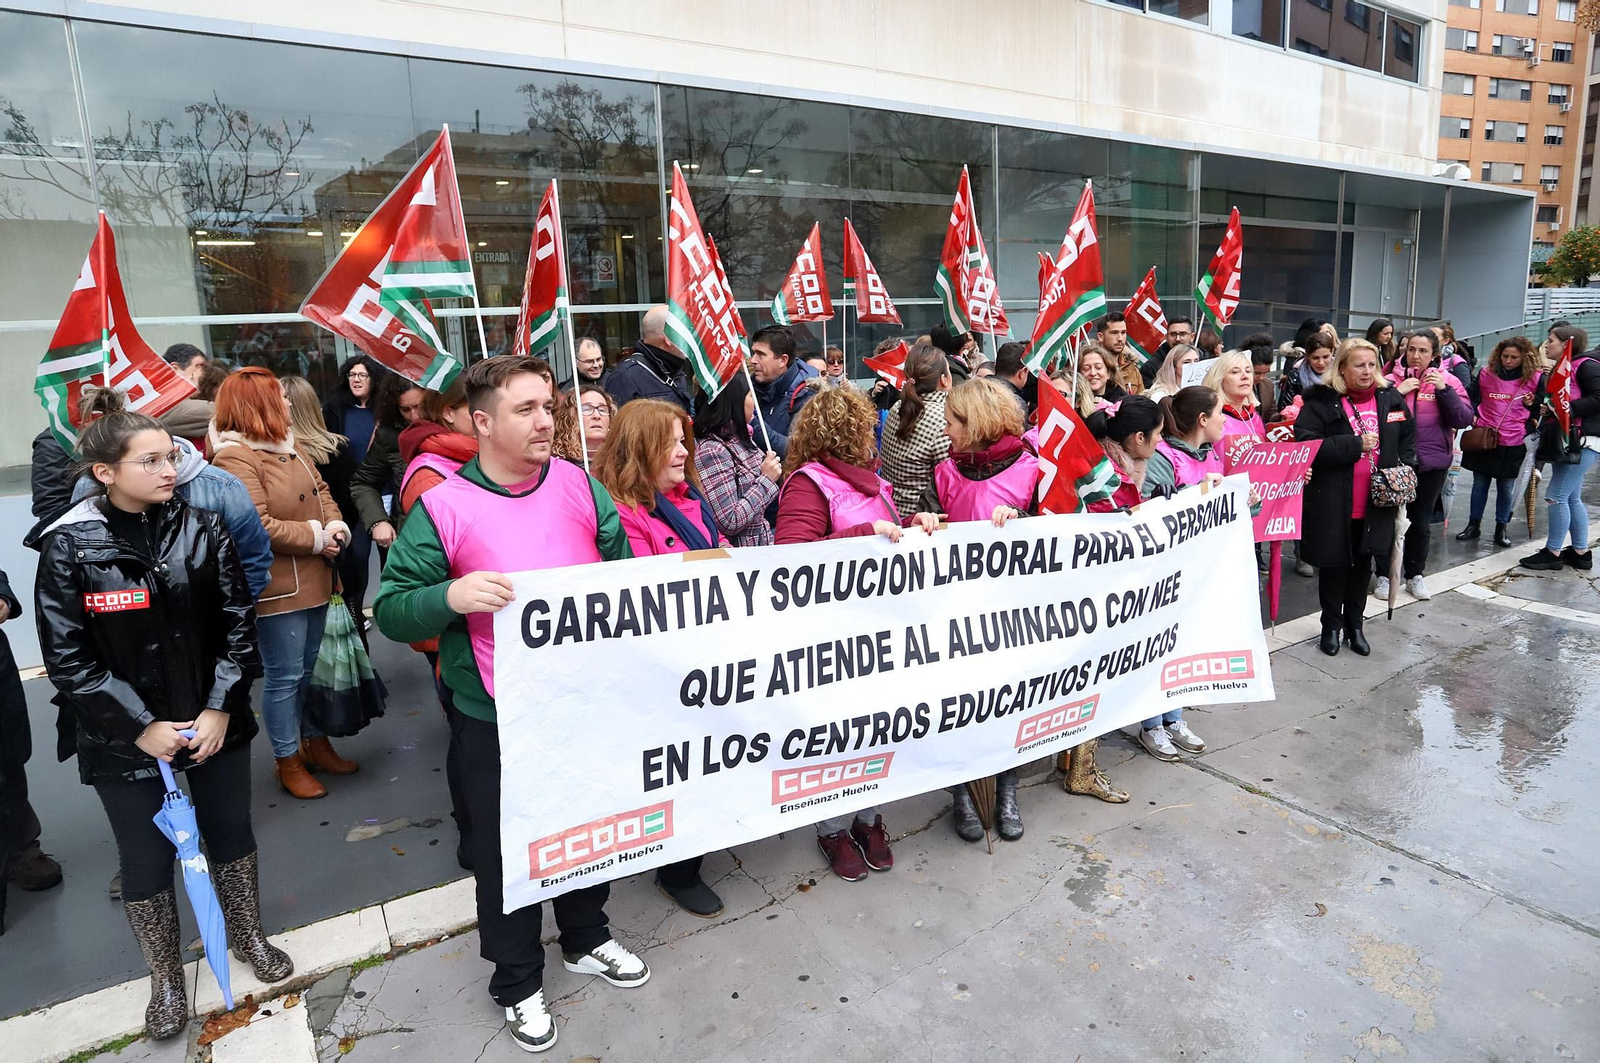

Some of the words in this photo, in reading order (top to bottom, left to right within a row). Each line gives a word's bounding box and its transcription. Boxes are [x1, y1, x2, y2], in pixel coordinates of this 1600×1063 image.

[475, 252, 510, 263] ENTRADA
[789, 273, 806, 316] Huelva
[688, 280, 731, 361] Huelva
[1252, 475, 1305, 501] ROGACIÓN
[1264, 516, 1296, 536] HUELVA
[521, 575, 729, 648] GARANTIA
[736, 570, 760, 616] Y
[770, 550, 925, 612] SOLUCION
[933, 537, 1062, 587] LABORAL
[1072, 530, 1135, 569] PARA
[1139, 524, 1165, 556] EL
[1165, 492, 1238, 549] PERSONAL
[85, 593, 132, 607] CCOO
[680, 659, 757, 709] QUE
[766, 630, 894, 698] ATIENDE
[904, 622, 940, 668] AL
[948, 597, 1098, 660] ALUMNADO
[1106, 589, 1149, 629] CON
[1148, 570, 1182, 612] NEE
[1164, 657, 1229, 682] CCOO
[643, 741, 690, 792] EN
[703, 732, 771, 776] LOS
[781, 700, 931, 761] CENTROS
[938, 660, 1092, 733] EDUCATIVOS
[1093, 622, 1179, 684] PUBLICOS
[1166, 684, 1210, 699] Enseñanza
[1212, 681, 1248, 690] Huelva
[1017, 731, 1060, 754] Enseñanza
[1061, 723, 1088, 740] Huelva
[1021, 704, 1080, 739] CCOO
[778, 762, 865, 796] CCOO
[780, 789, 839, 814] Enseñanza
[842, 781, 879, 800] Huelva
[538, 815, 644, 872] CCOO
[540, 858, 615, 889] Enseñanza
[618, 844, 664, 864] Huelva
